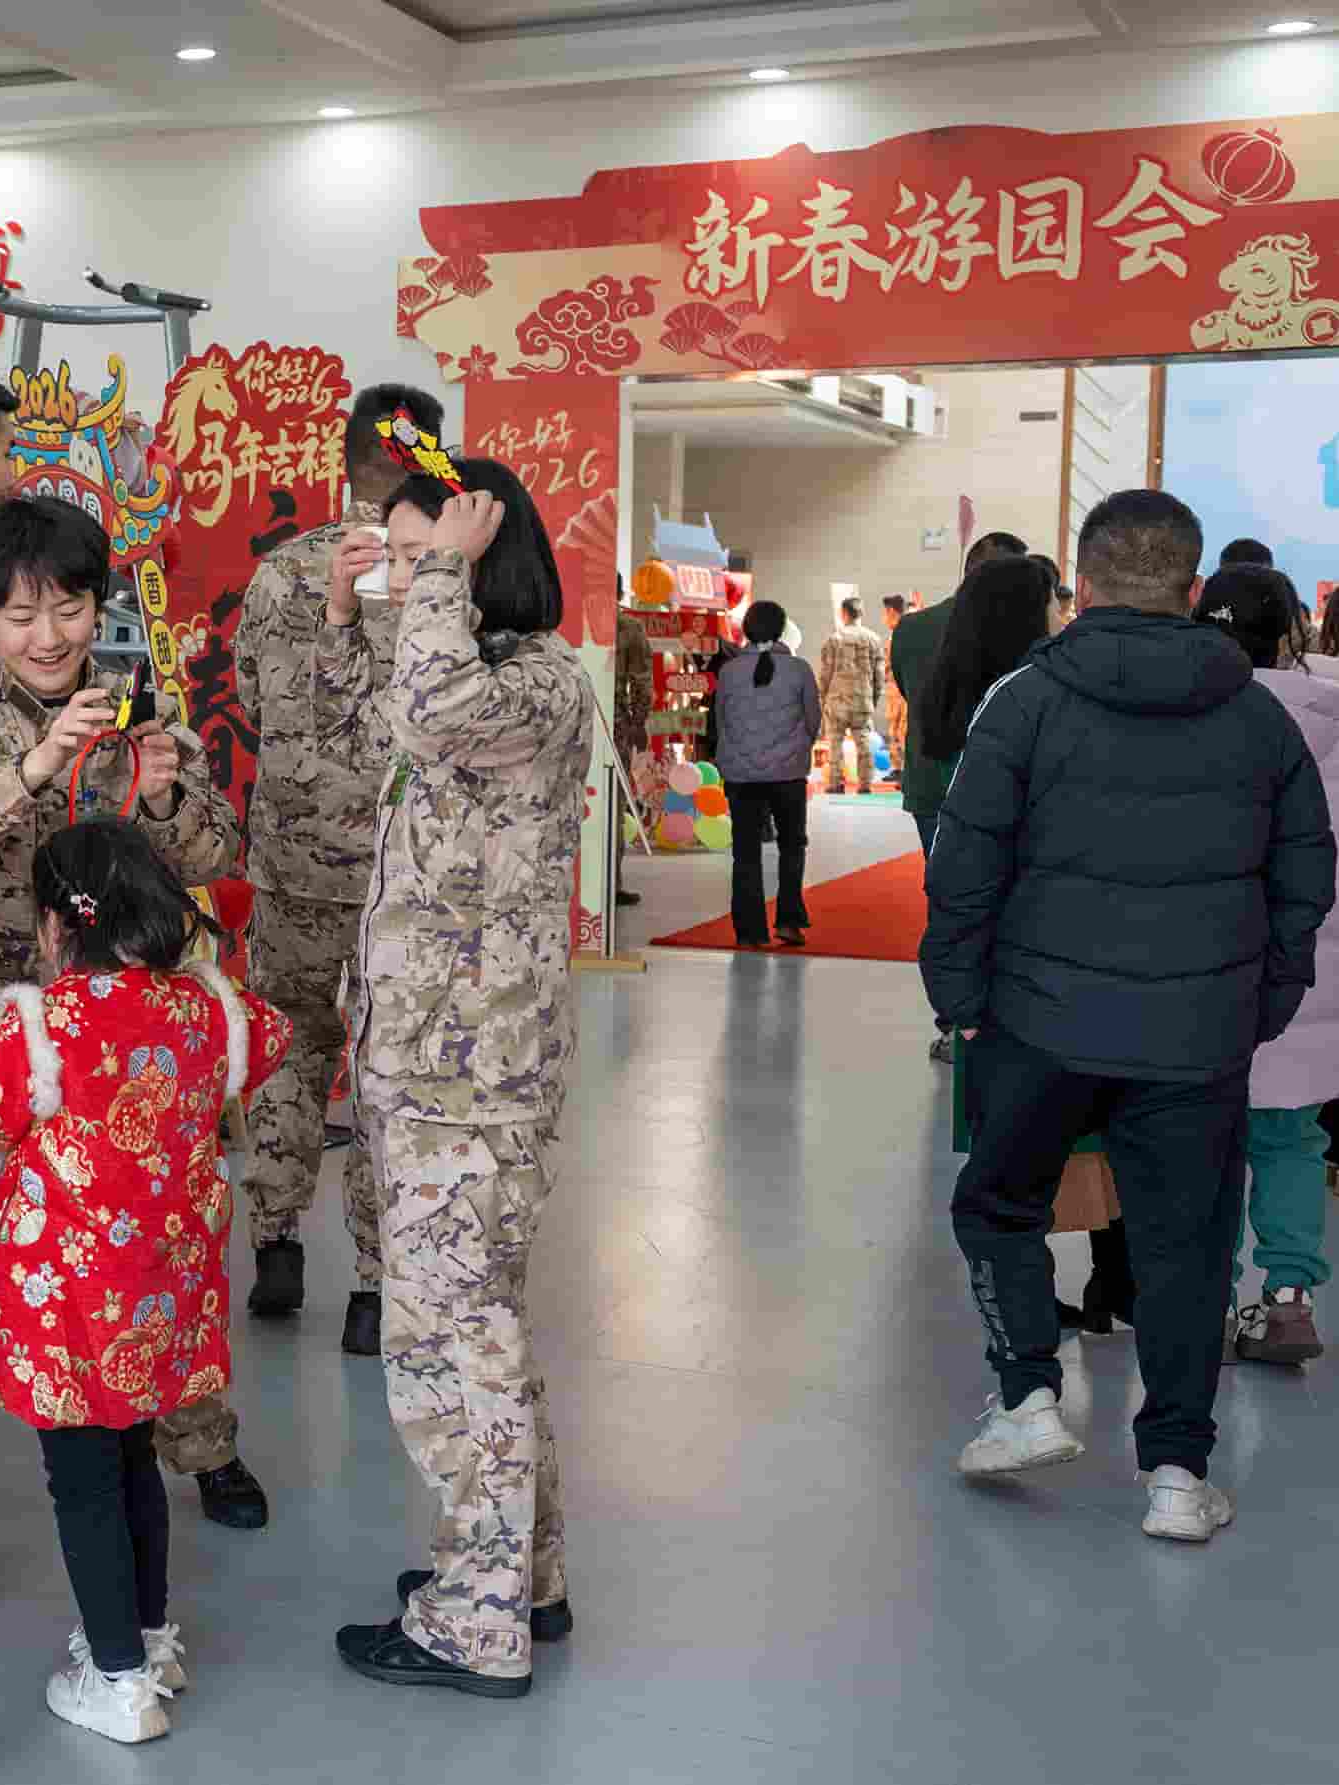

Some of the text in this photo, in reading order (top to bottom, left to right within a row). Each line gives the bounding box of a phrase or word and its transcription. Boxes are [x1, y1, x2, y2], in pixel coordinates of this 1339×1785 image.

[687, 158, 1223, 310] 新春游园会
[11, 360, 78, 432] 2026
[476, 410, 576, 460] 你好
[182, 415, 348, 528] 马年吉祥
[519, 447, 601, 496] 026
